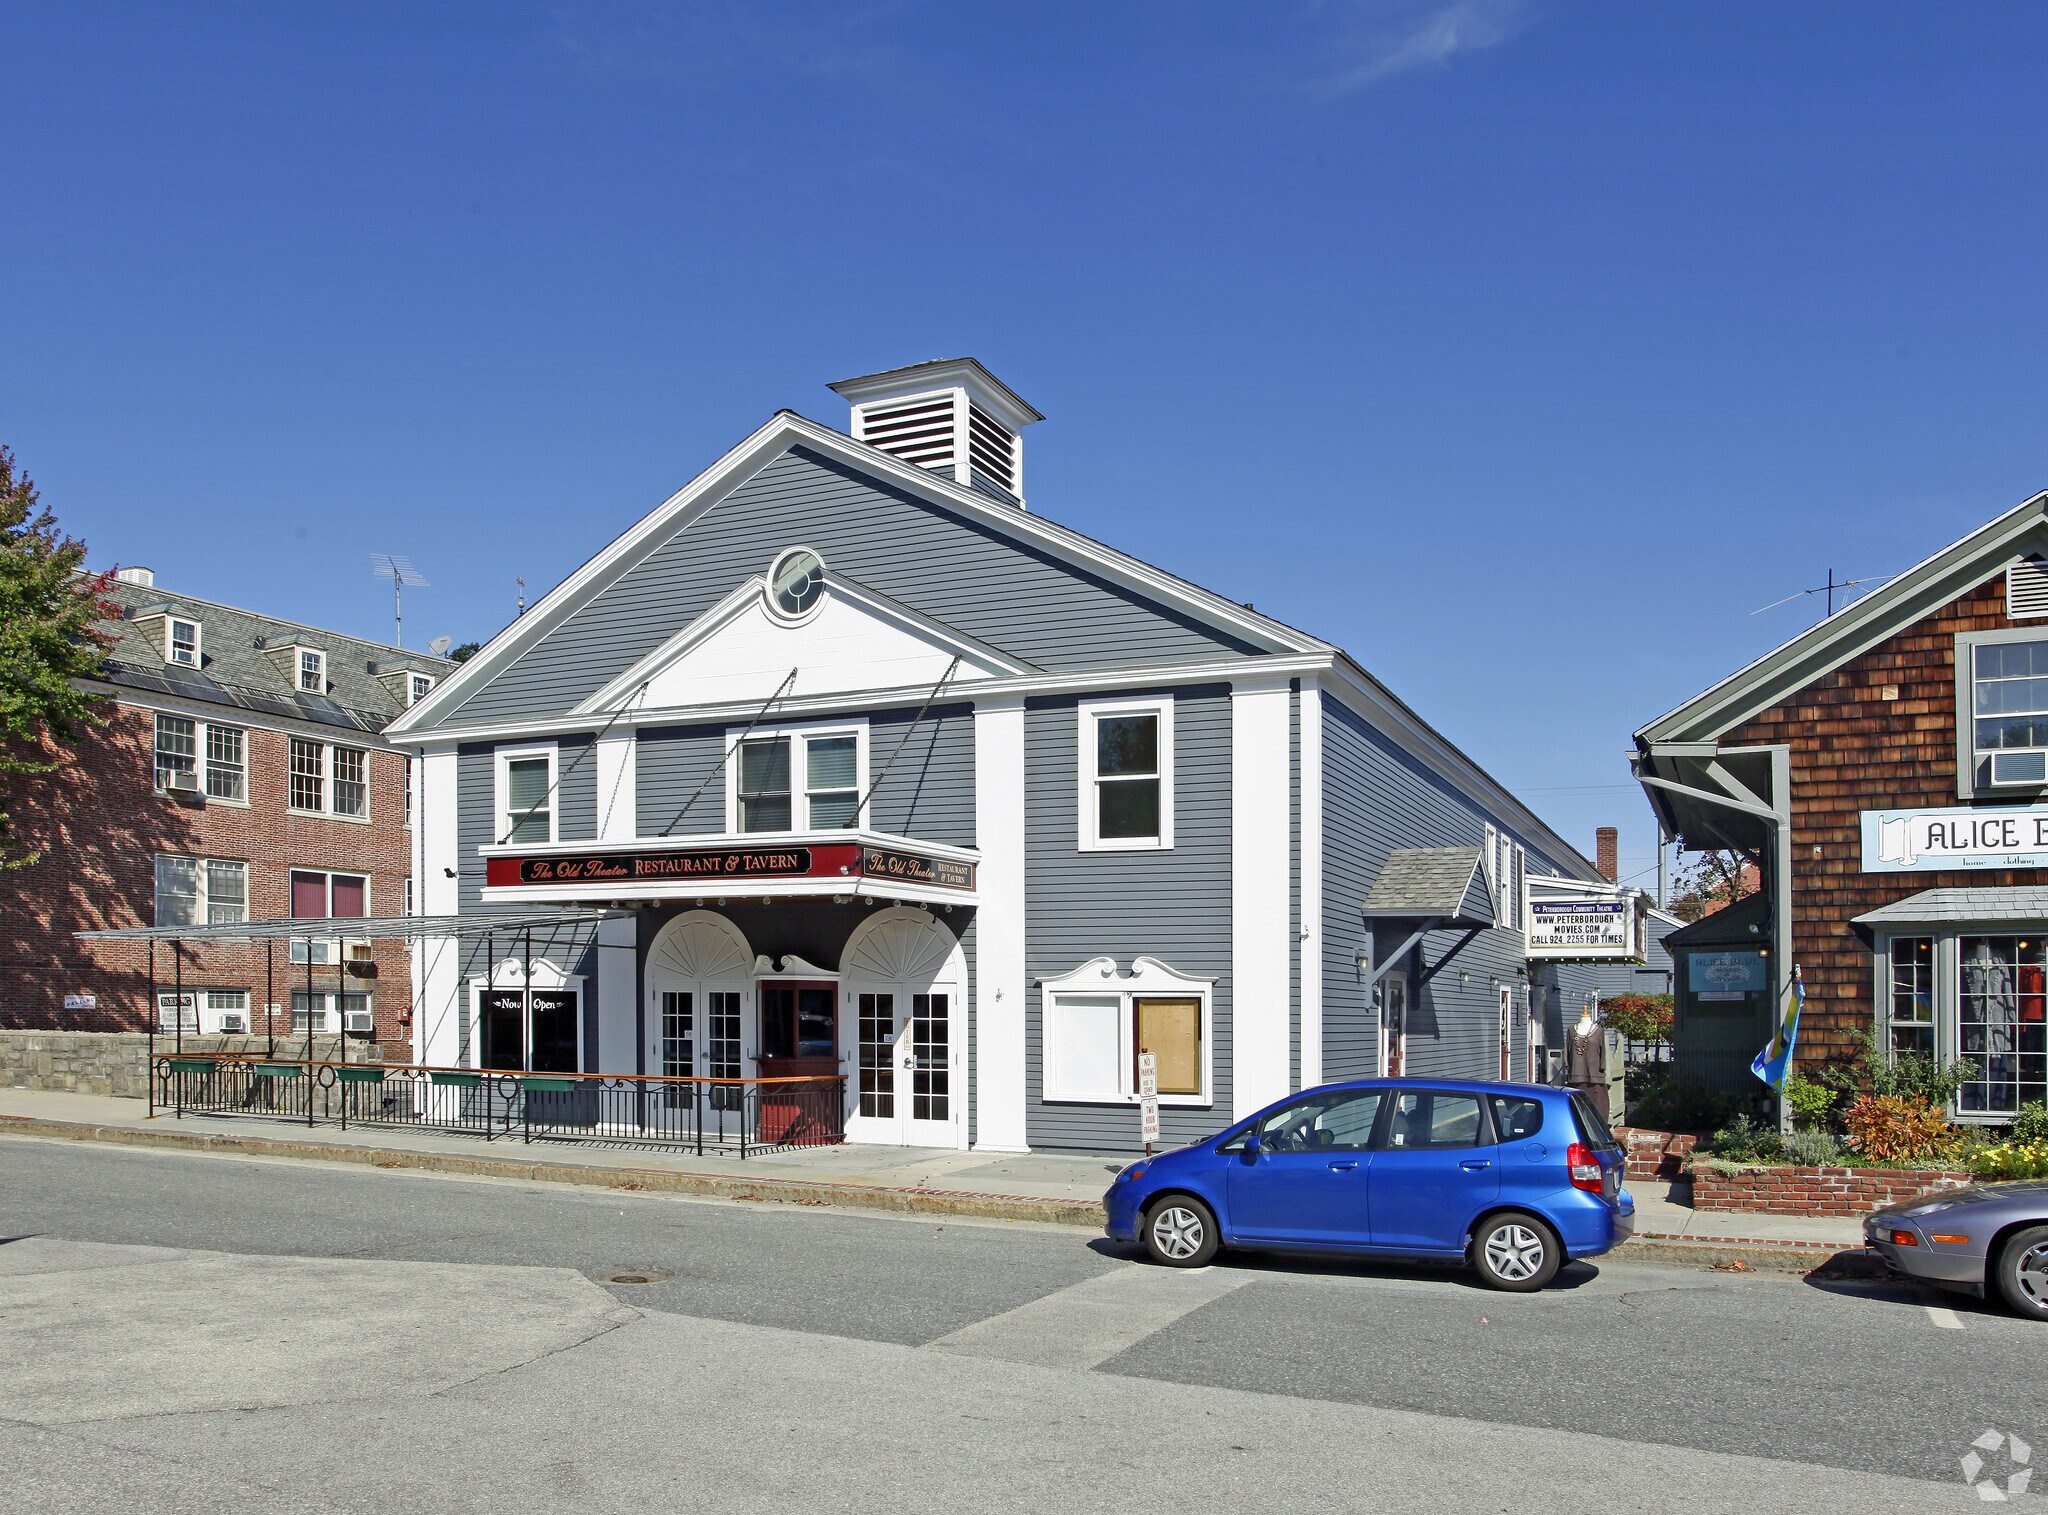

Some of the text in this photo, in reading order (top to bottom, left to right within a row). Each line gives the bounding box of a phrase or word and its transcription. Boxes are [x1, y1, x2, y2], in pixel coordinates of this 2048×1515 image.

[1924, 818, 2020, 850] ALICE
[1962, 855, 2035, 866] home clothing
[530, 854, 798, 879] The Old Theater RESTAURANT & TAVERN
[869, 853, 936, 879] The Old Theater
[937, 862, 968, 875] RESTAURANT
[940, 872, 966, 883] & TAVERN
[1542, 905, 1572, 913] PETERBOROUGH
[1572, 904, 1595, 913] COMMUNITY
[1554, 925, 1600, 934] MOVIES.COM
[1531, 935, 1548, 944] CALL
[1586, 934, 1599, 944] FOR
[1601, 934, 1623, 944] TIMES
[1695, 957, 1760, 967] ALICE BLUE
[501, 998, 556, 1012] Now Open
[1144, 1058, 1150, 1066] NO
[1140, 1068, 1154, 1076] PARKING
[1146, 1106, 1154, 1114] TWO
[1146, 1116, 1155, 1124] HOUR
[1144, 1125, 1157, 1133] PARKING
